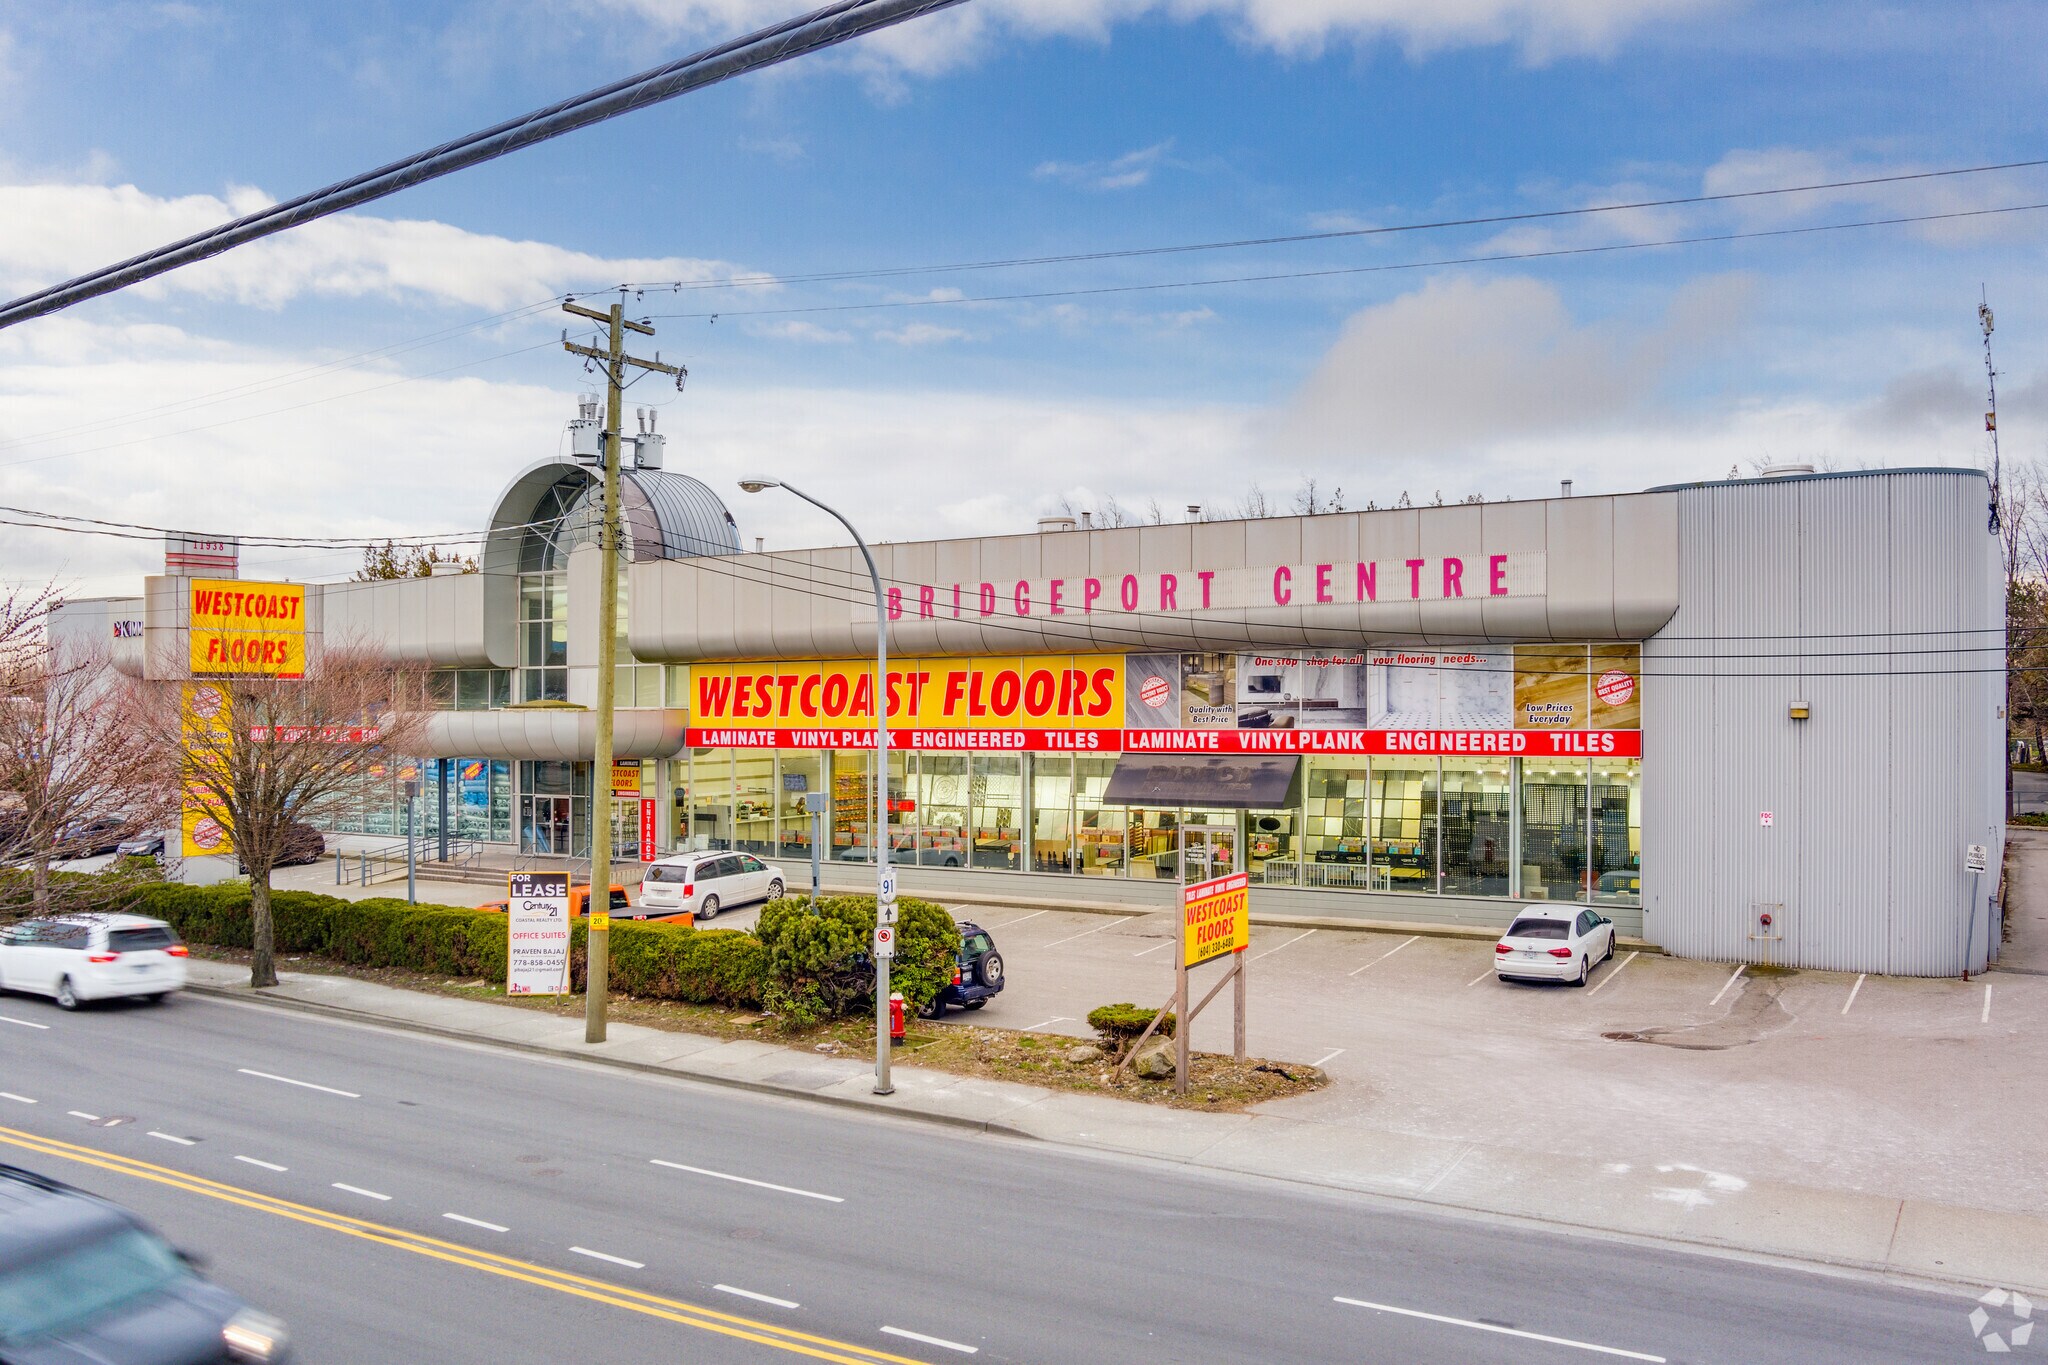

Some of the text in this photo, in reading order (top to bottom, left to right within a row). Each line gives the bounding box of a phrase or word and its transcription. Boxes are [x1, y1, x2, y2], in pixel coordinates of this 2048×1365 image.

[193, 540, 224, 550] 11938
[888, 555, 1508, 620] BRIDGEPORT CENTRE
[195, 590, 300, 619] WESTCOAST
[207, 638, 288, 664] FLOORS
[1255, 656, 1298, 668] One stop
[1306, 653, 1364, 667] shop for all
[1373, 656, 1395, 667] your
[1397, 653, 1436, 667] flooring
[698, 667, 1116, 718] WESTCOAST FLOORS
[1189, 706, 1215, 714] Quality
[1526, 703, 1573, 712] Low Prices
[1529, 714, 1571, 724] Everyday
[702, 731, 776, 746] LAMINATE
[792, 731, 840, 747] VINYL
[912, 731, 1026, 748] ENGINEERED
[1045, 731, 1099, 748] TILES
[1129, 732, 1615, 752] LAMINATE VINYL PLANK ENGINEERED TILES
[612, 769, 639, 778] STCOAST
[611, 779, 632, 787] LOORS
[510, 874, 531, 882] FOR
[512, 884, 566, 896] LEASE
[883, 880, 894, 894] 91
[522, 900, 552, 910] Century
[549, 907, 558, 916] 21
[1187, 892, 1245, 926] WESTCOAST
[512, 932, 538, 940] OFFICE
[1197, 916, 1234, 945] FLOORS
[1198, 944, 1211, 960] (604)
